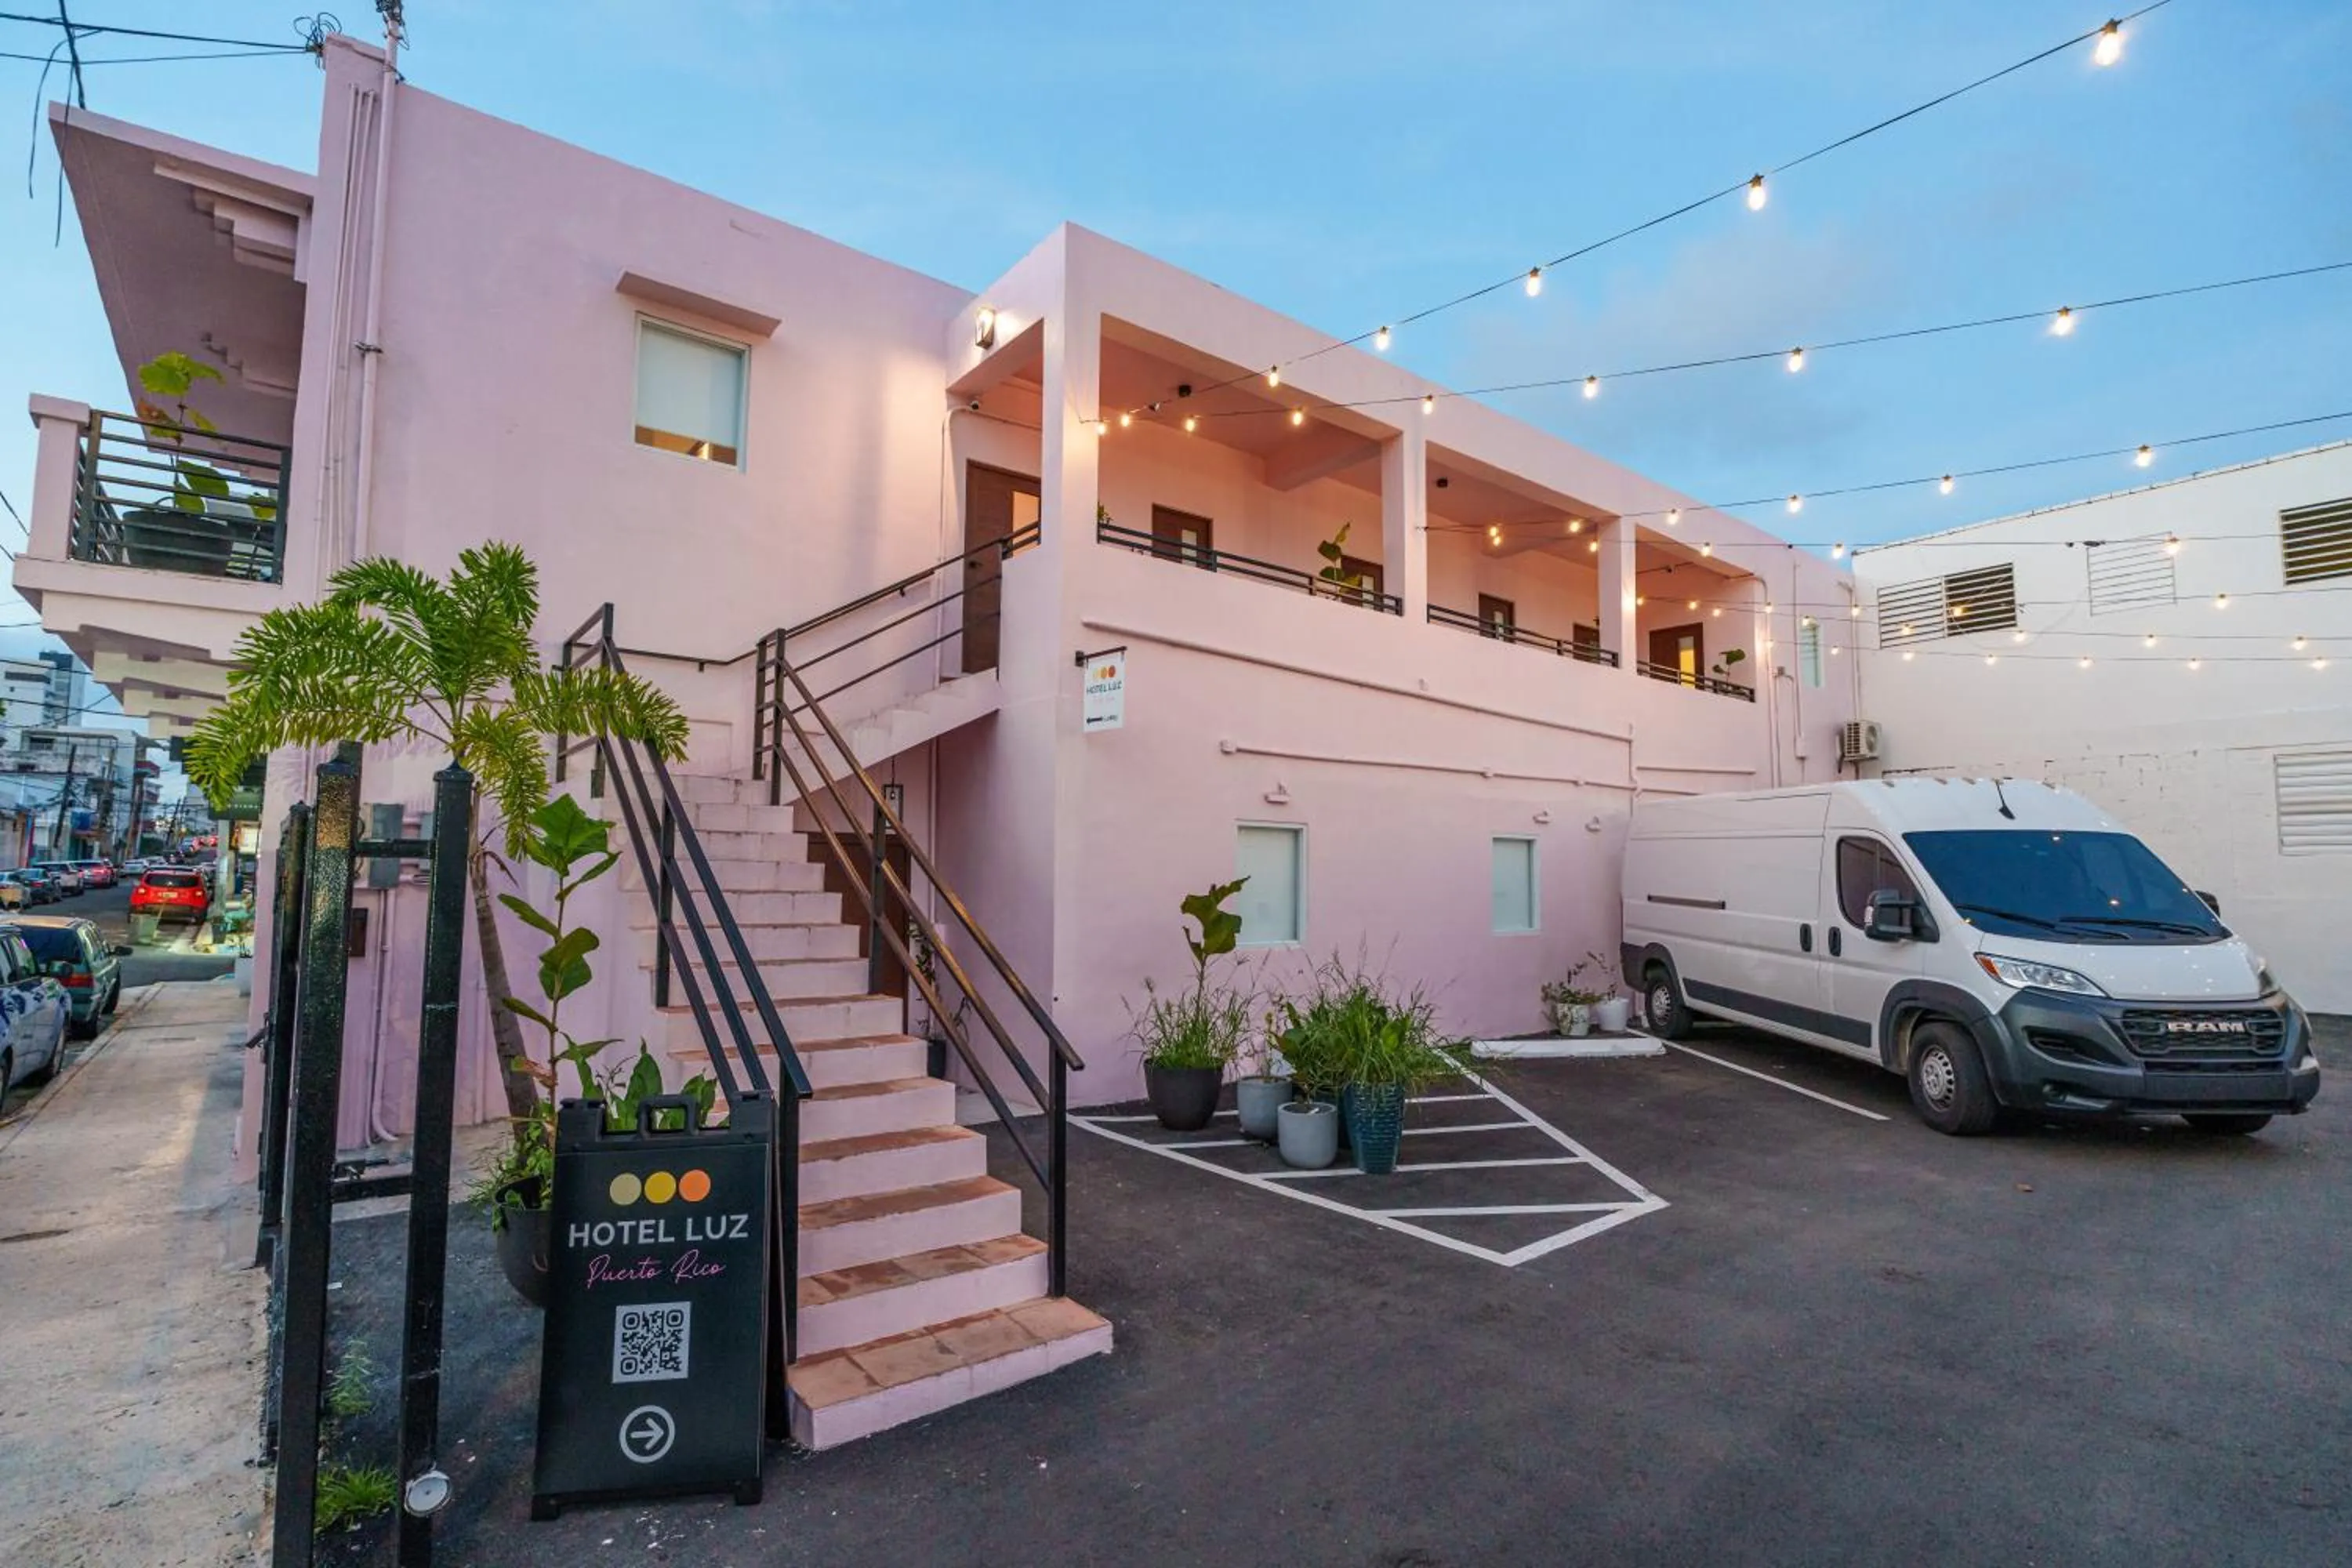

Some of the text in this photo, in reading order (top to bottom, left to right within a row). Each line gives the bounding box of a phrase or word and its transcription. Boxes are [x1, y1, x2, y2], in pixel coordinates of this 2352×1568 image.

[2167, 1022, 2245, 1033] RAM
[568, 1214, 749, 1248] HOTEL LUZ
[586, 1249, 726, 1290] Puerto Rico
